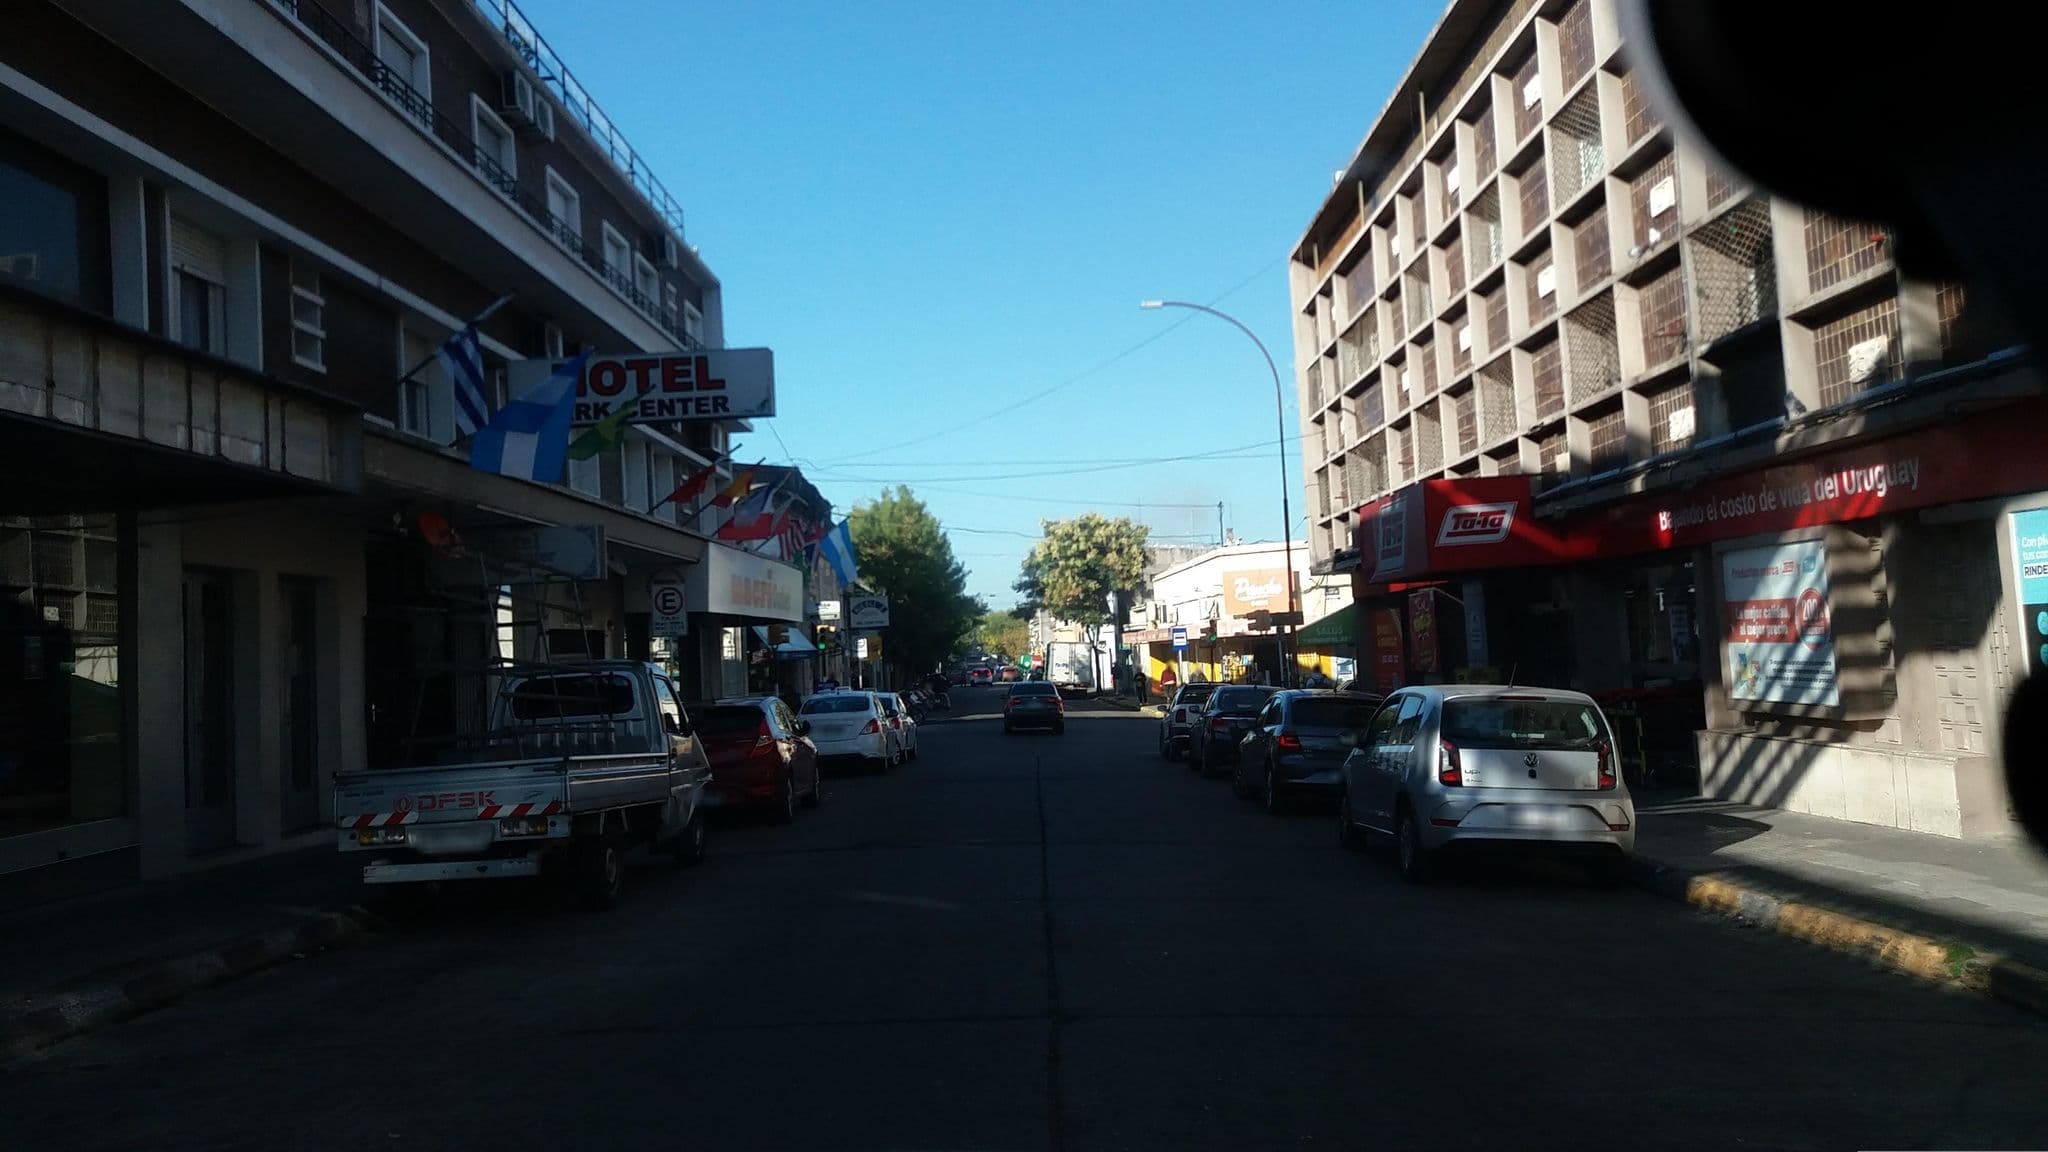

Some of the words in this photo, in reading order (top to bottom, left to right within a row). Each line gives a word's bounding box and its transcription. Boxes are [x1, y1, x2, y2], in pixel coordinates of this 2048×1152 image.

[1658, 500, 1704, 533] Bajando
[1706, 495, 1718, 520] el
[1720, 492, 1756, 519] costo
[1759, 484, 1777, 512] de
[1779, 482, 1811, 508] vida
[1813, 472, 1840, 501] del
[1842, 456, 1920, 498] Uruguay
[662, 592, 676, 610] E
[417, 790, 496, 811] DFSK
